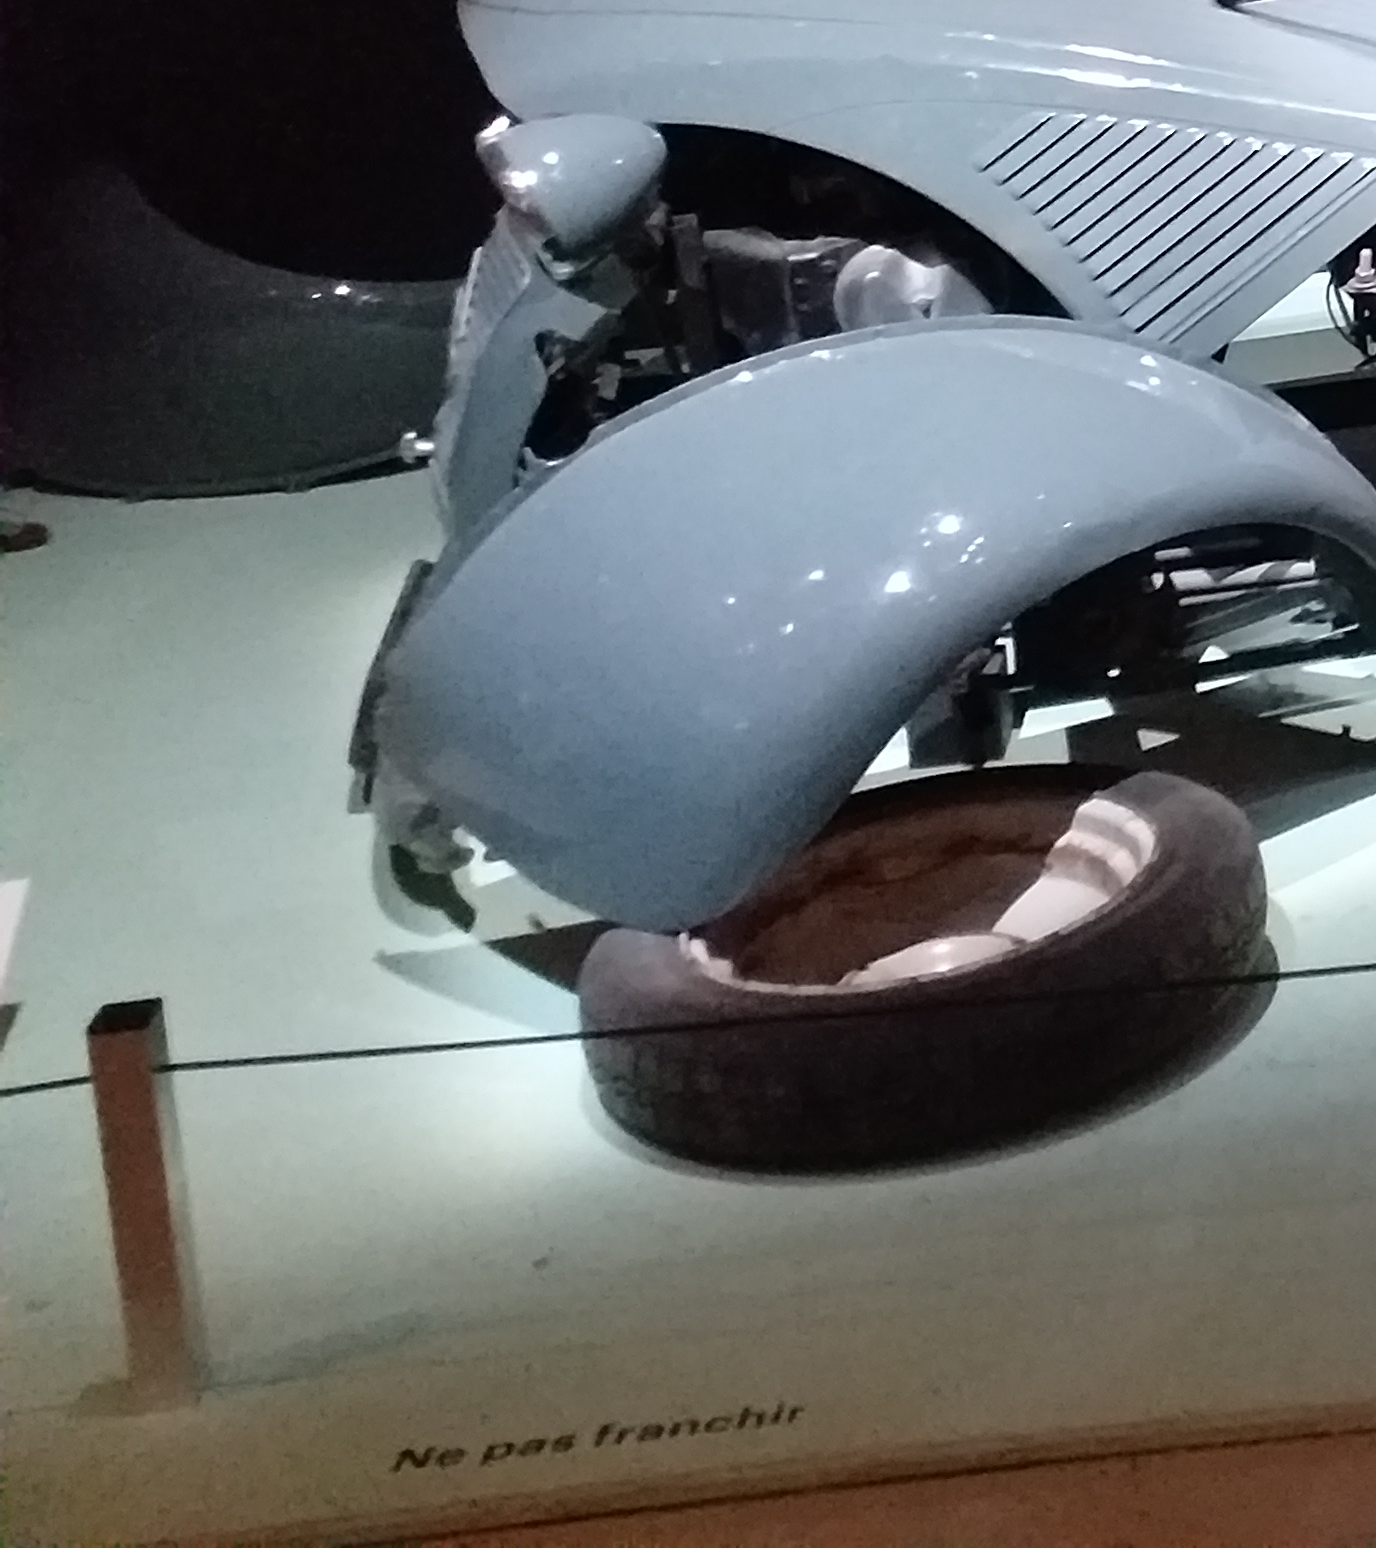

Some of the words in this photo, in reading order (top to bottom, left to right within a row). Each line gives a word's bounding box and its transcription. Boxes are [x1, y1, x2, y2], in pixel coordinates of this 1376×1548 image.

[389, 1444, 469, 1474] Ne
[478, 1431, 577, 1468] pas
[594, 1400, 805, 1449] franchir
